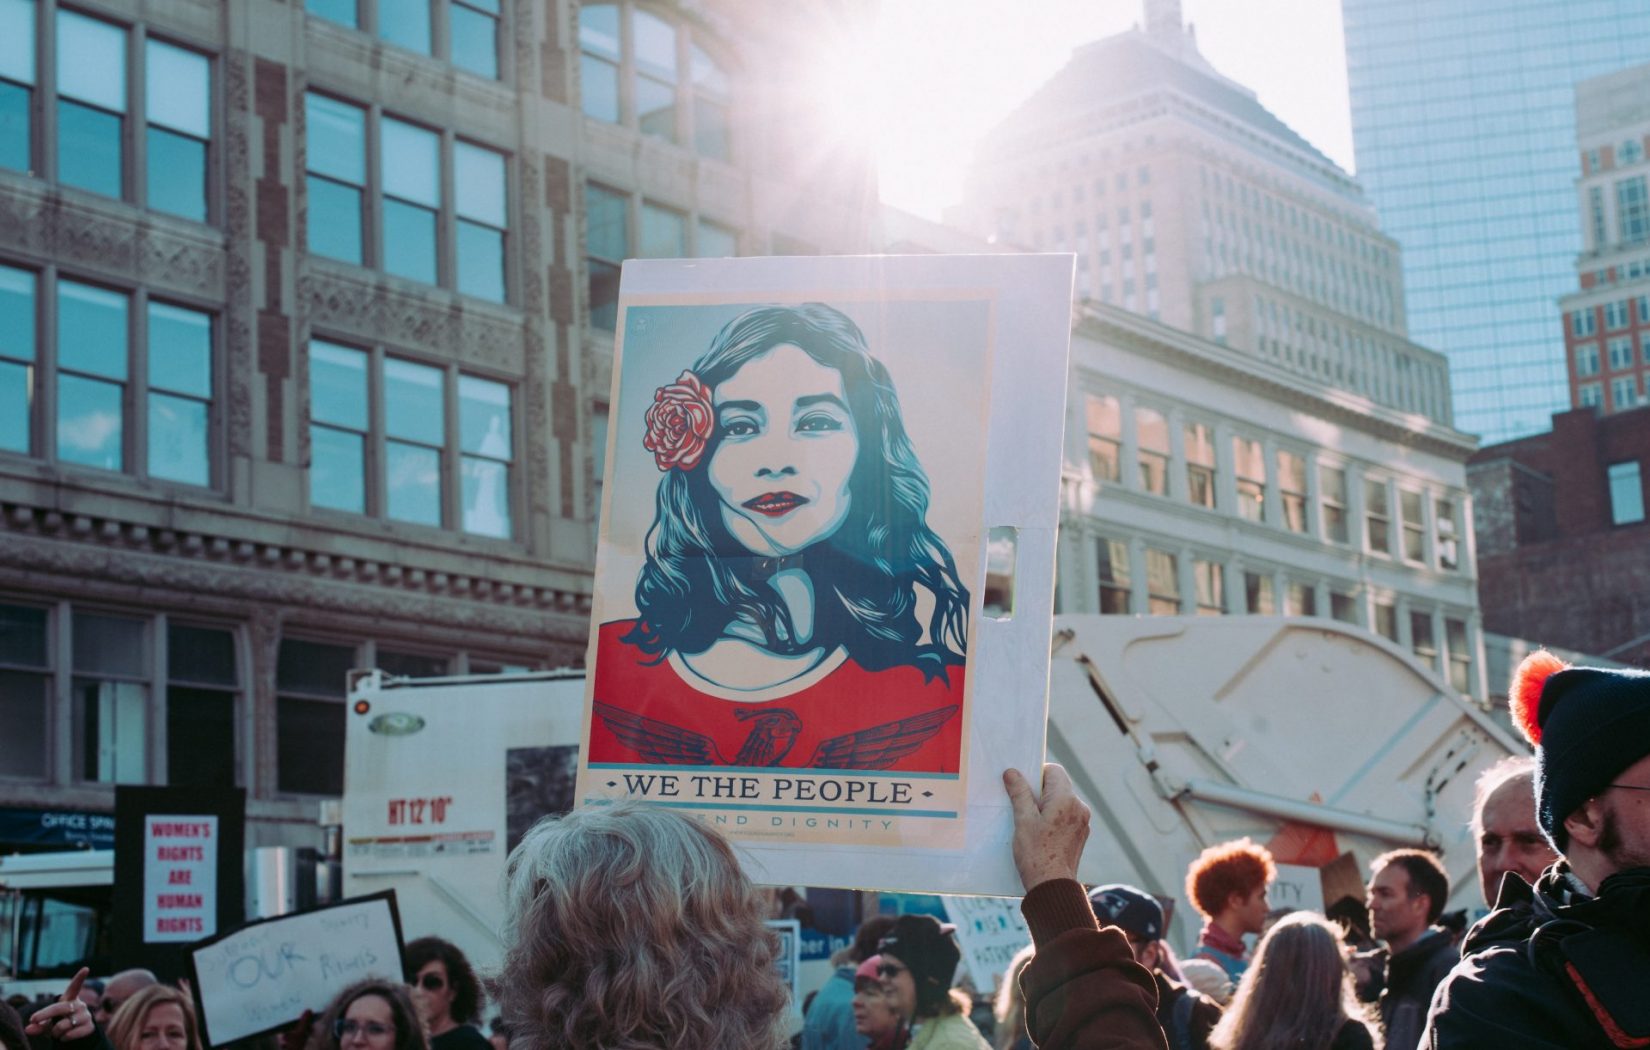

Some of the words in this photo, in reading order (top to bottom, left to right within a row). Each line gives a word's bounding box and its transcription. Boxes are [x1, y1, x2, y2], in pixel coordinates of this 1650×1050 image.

[622, 774, 680, 796] WE
[691, 776, 760, 799] THE
[773, 778, 913, 804] PEOPLE
[388, 799, 406, 825] HT
[42, 813, 86, 829] OFFICE
[697, 813, 748, 825] END
[772, 815, 893, 830] DIGNITY
[151, 822, 210, 839] WOMEN'S
[157, 845, 204, 861] RIGHTS
[168, 869, 192, 886] ARE
[157, 894, 203, 909] HUMAN
[156, 917, 203, 933] RIGHTS
